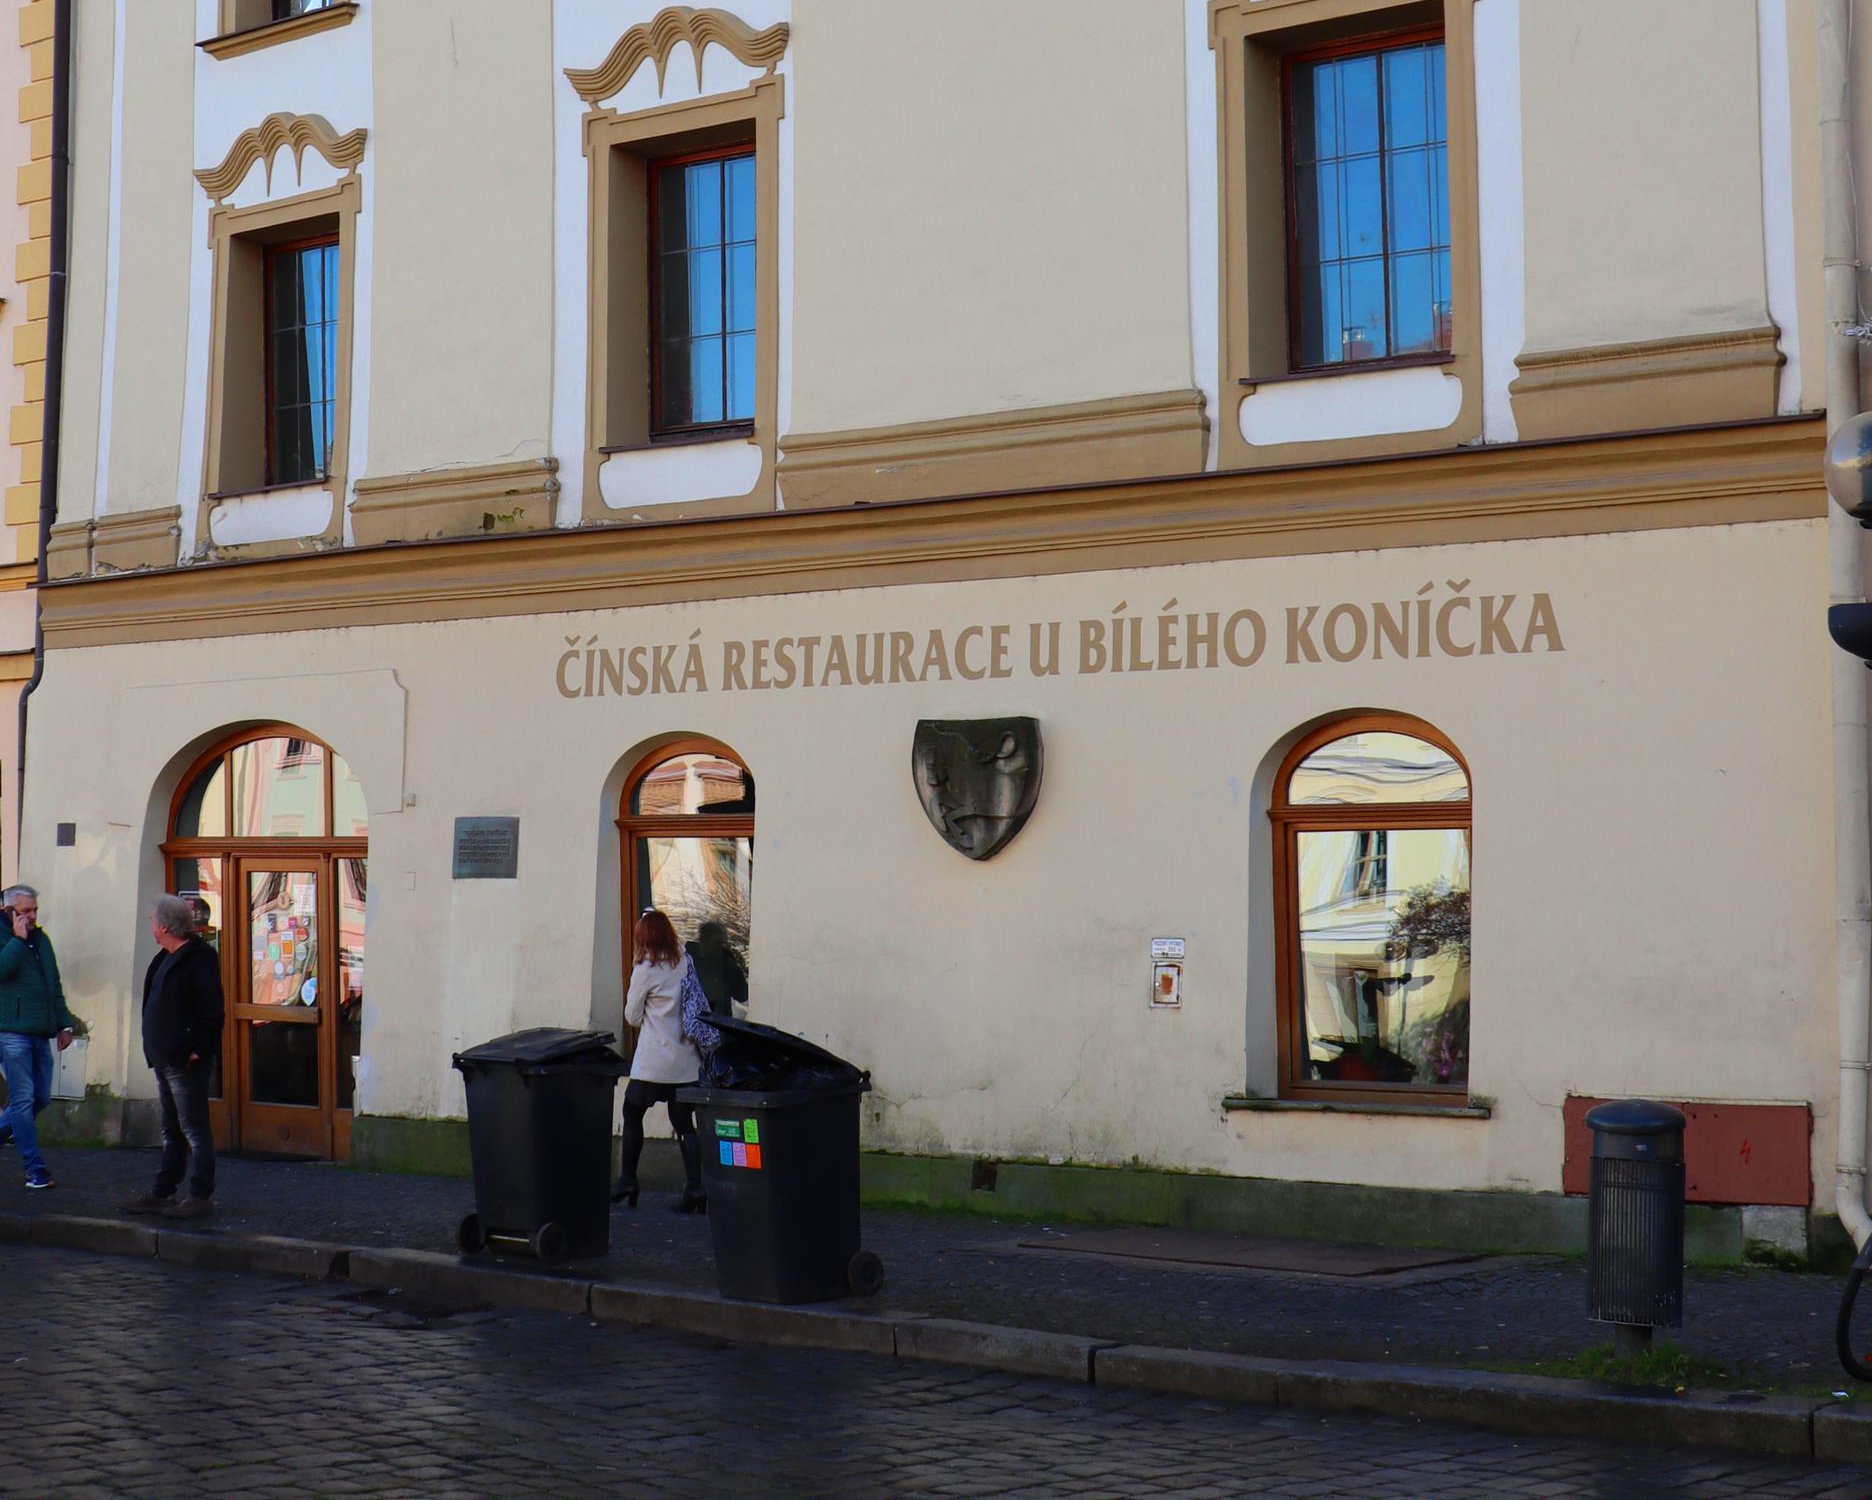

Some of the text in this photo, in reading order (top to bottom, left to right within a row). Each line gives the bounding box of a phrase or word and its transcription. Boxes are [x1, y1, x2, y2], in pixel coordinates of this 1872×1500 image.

[556, 578, 1566, 699] ČÍNSKÁ RESTAURACE U BÍLÉHO KONÍČKA
